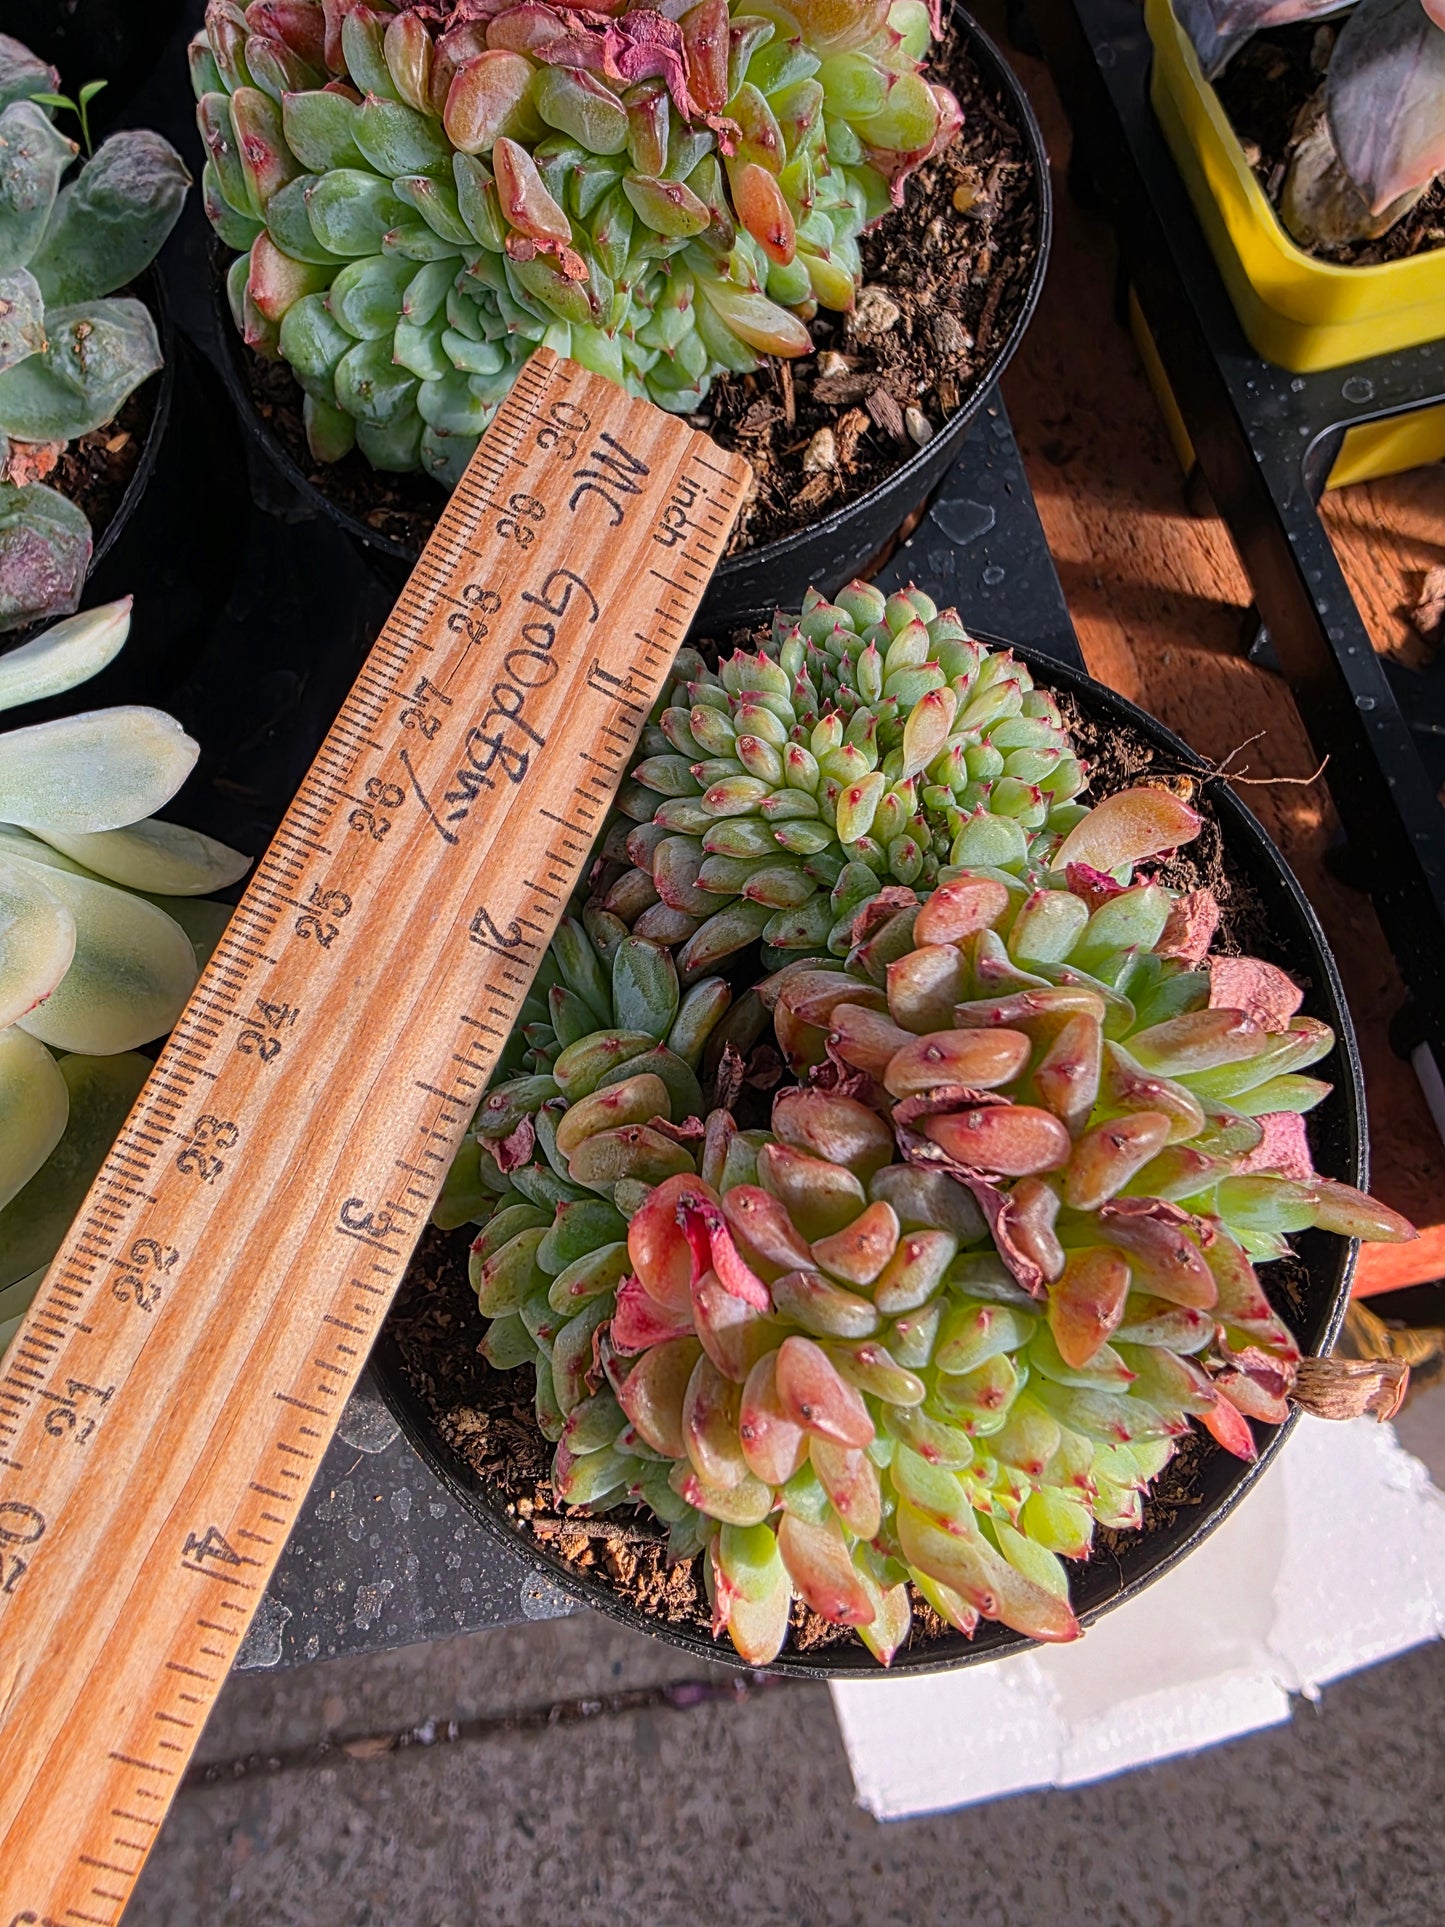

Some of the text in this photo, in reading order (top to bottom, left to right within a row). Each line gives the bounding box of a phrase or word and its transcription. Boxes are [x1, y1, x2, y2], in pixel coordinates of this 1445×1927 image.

[44, 1378, 114, 1445] 21
[112, 1238, 180, 1312] 22
[176, 1114, 240, 1185] 23
[237, 996, 299, 1063] 24
[295, 883, 353, 948] 25
[348, 775, 406, 843] 26
[400, 676, 453, 740] 27
[447, 583, 501, 645] 28
[497, 492, 546, 549] 29
[535, 400, 591, 461] 30
[569, 432, 650, 526] MC
[182, 476, 707, 1567] inch 1 2 3 4
